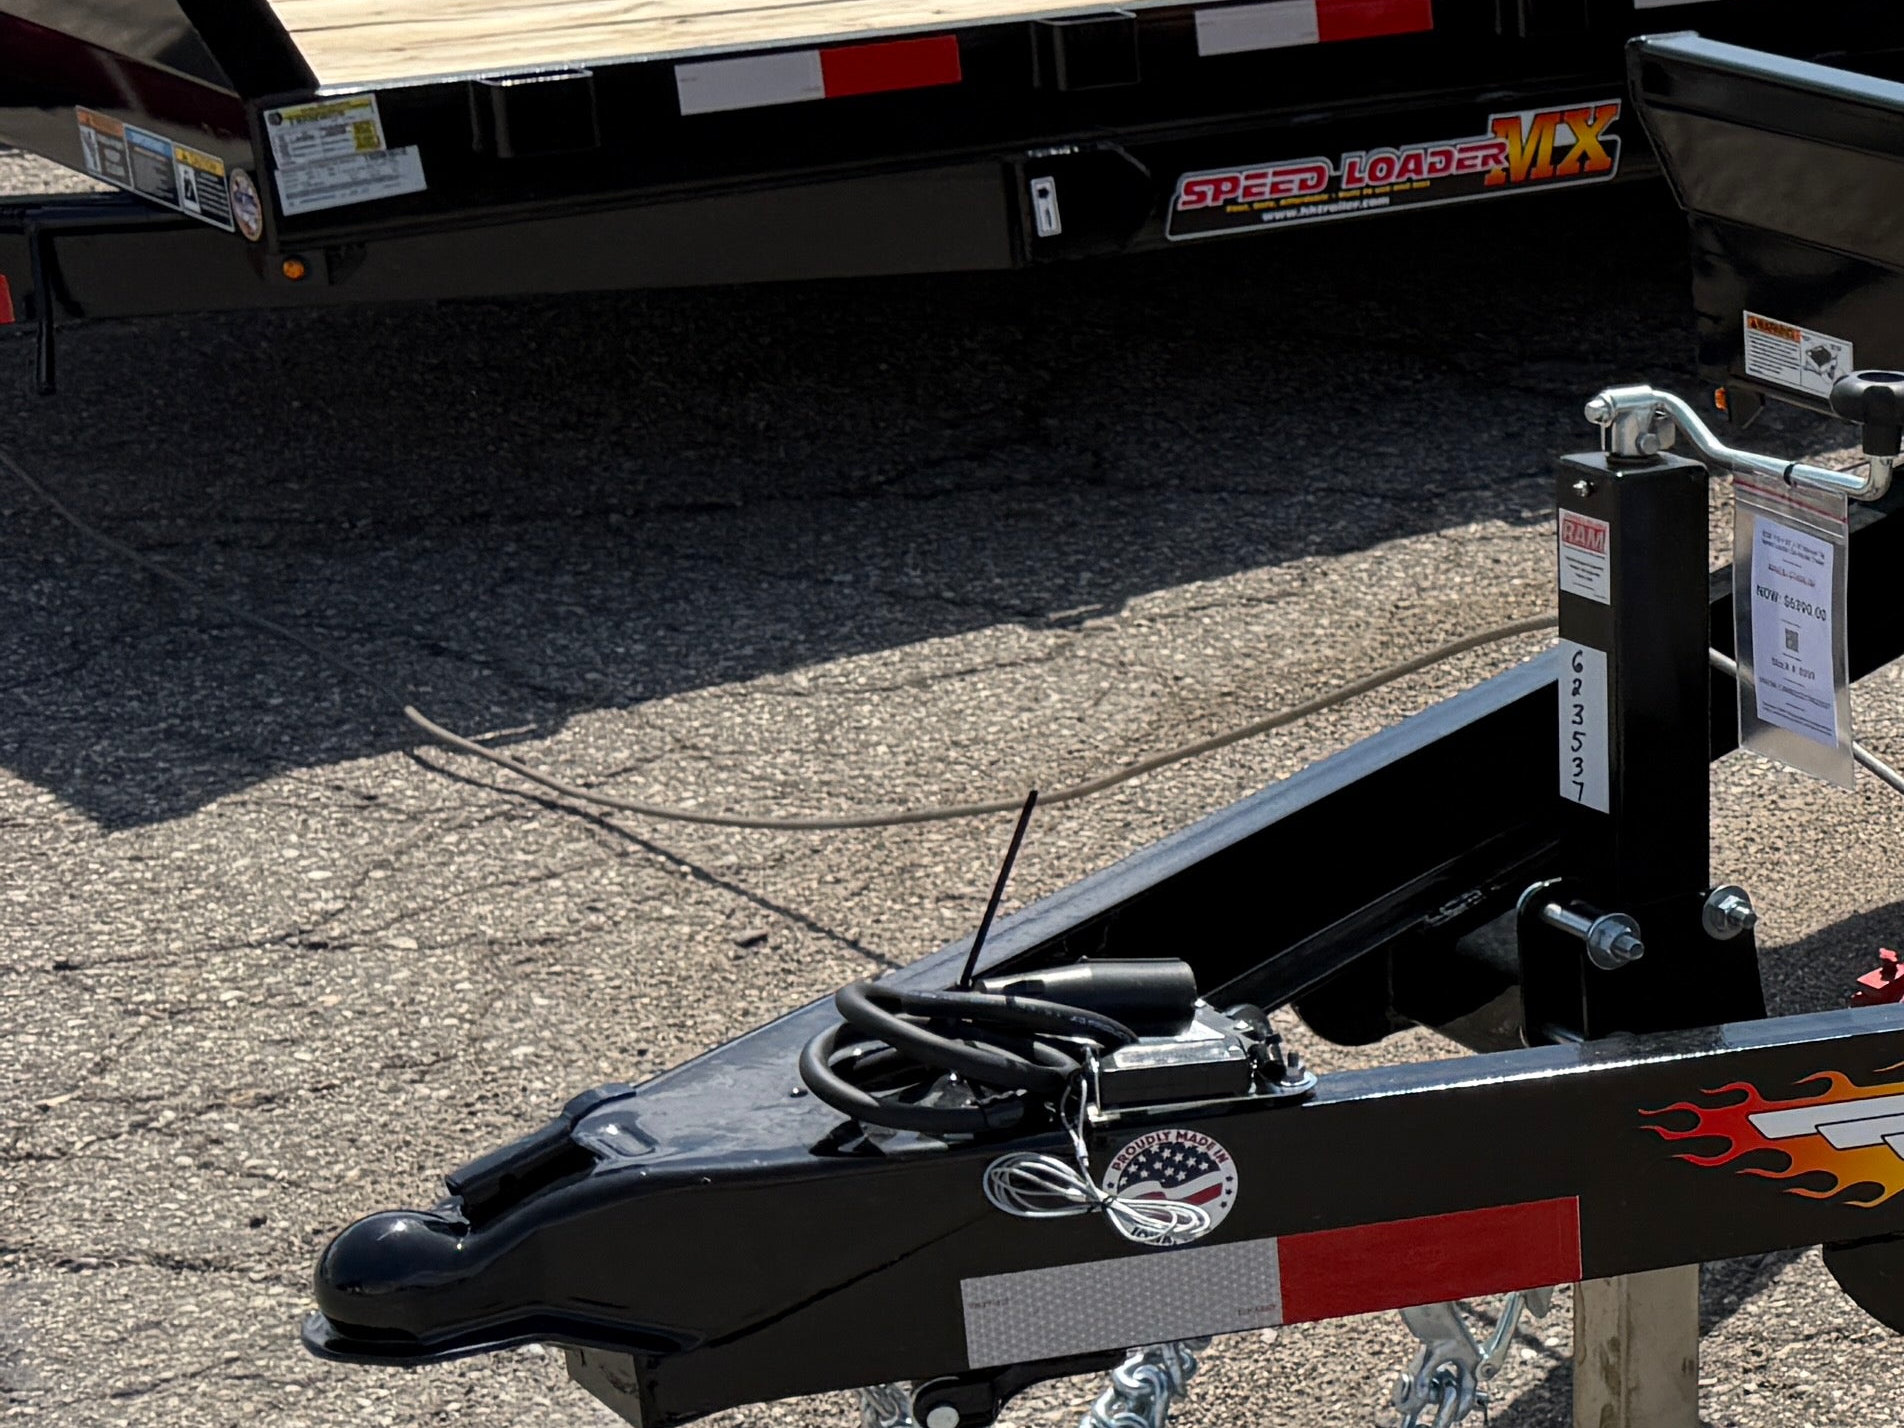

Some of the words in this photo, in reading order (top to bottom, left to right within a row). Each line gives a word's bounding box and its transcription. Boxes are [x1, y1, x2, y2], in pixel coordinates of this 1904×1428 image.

[1178, 163, 1330, 210] SPEED
[1343, 140, 1509, 189] LOADER
[1485, 103, 1621, 187] MX
[1111, 1130, 1171, 1172] PROUDLY
[1175, 1130, 1217, 1152] MADE
[1213, 1148, 1230, 1164] IN
